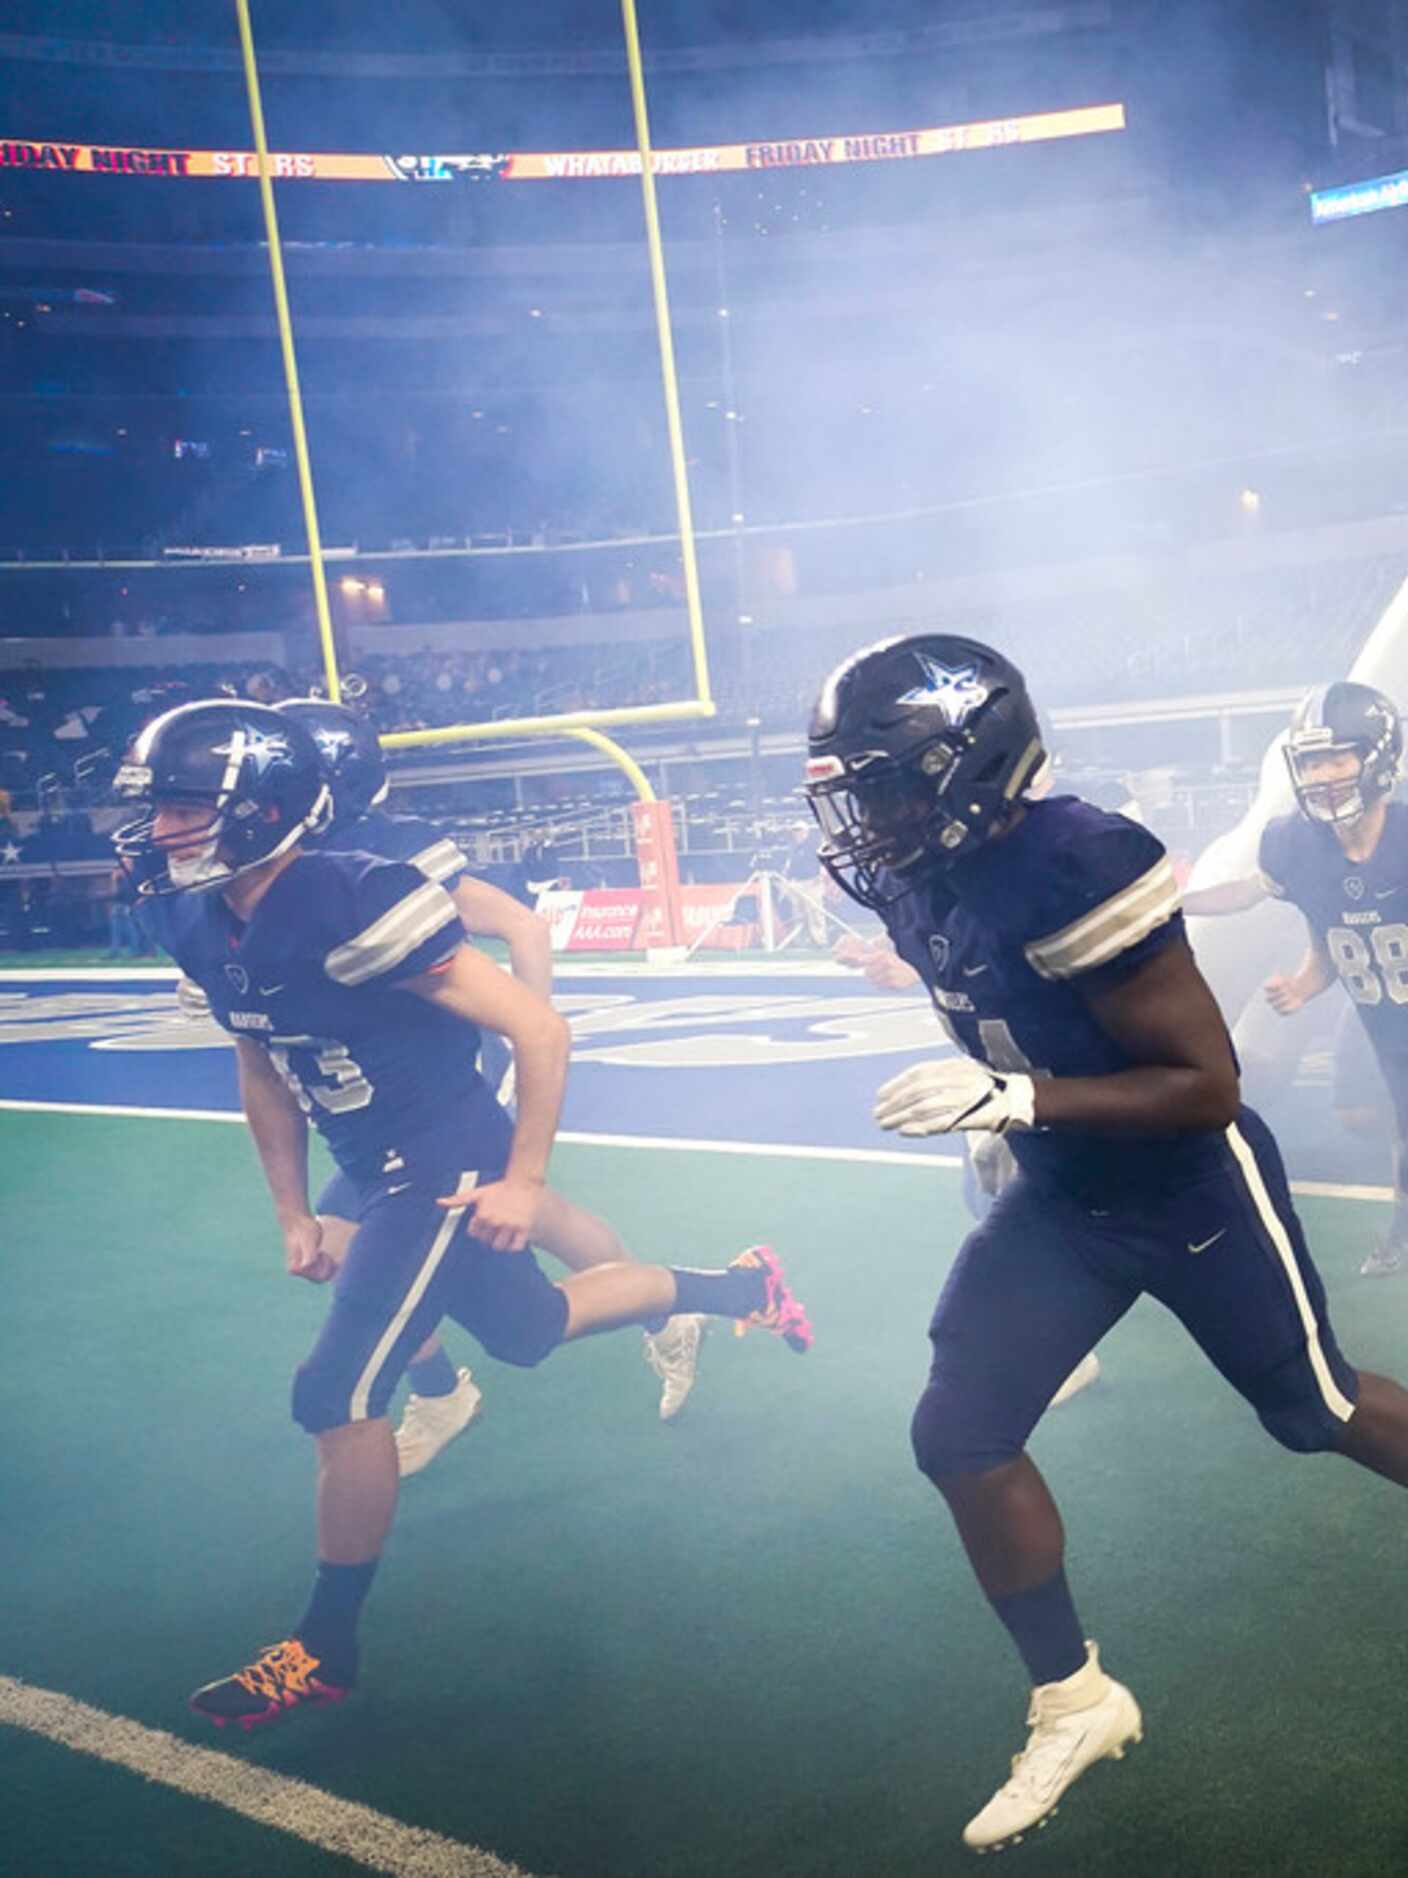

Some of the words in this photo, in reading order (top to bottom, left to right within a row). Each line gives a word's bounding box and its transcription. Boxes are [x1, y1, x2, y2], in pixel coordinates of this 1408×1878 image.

[91, 148, 192, 176] NIGHT
[745, 139, 834, 168] FRIDAY
[845, 133, 922, 162] NIGHT
